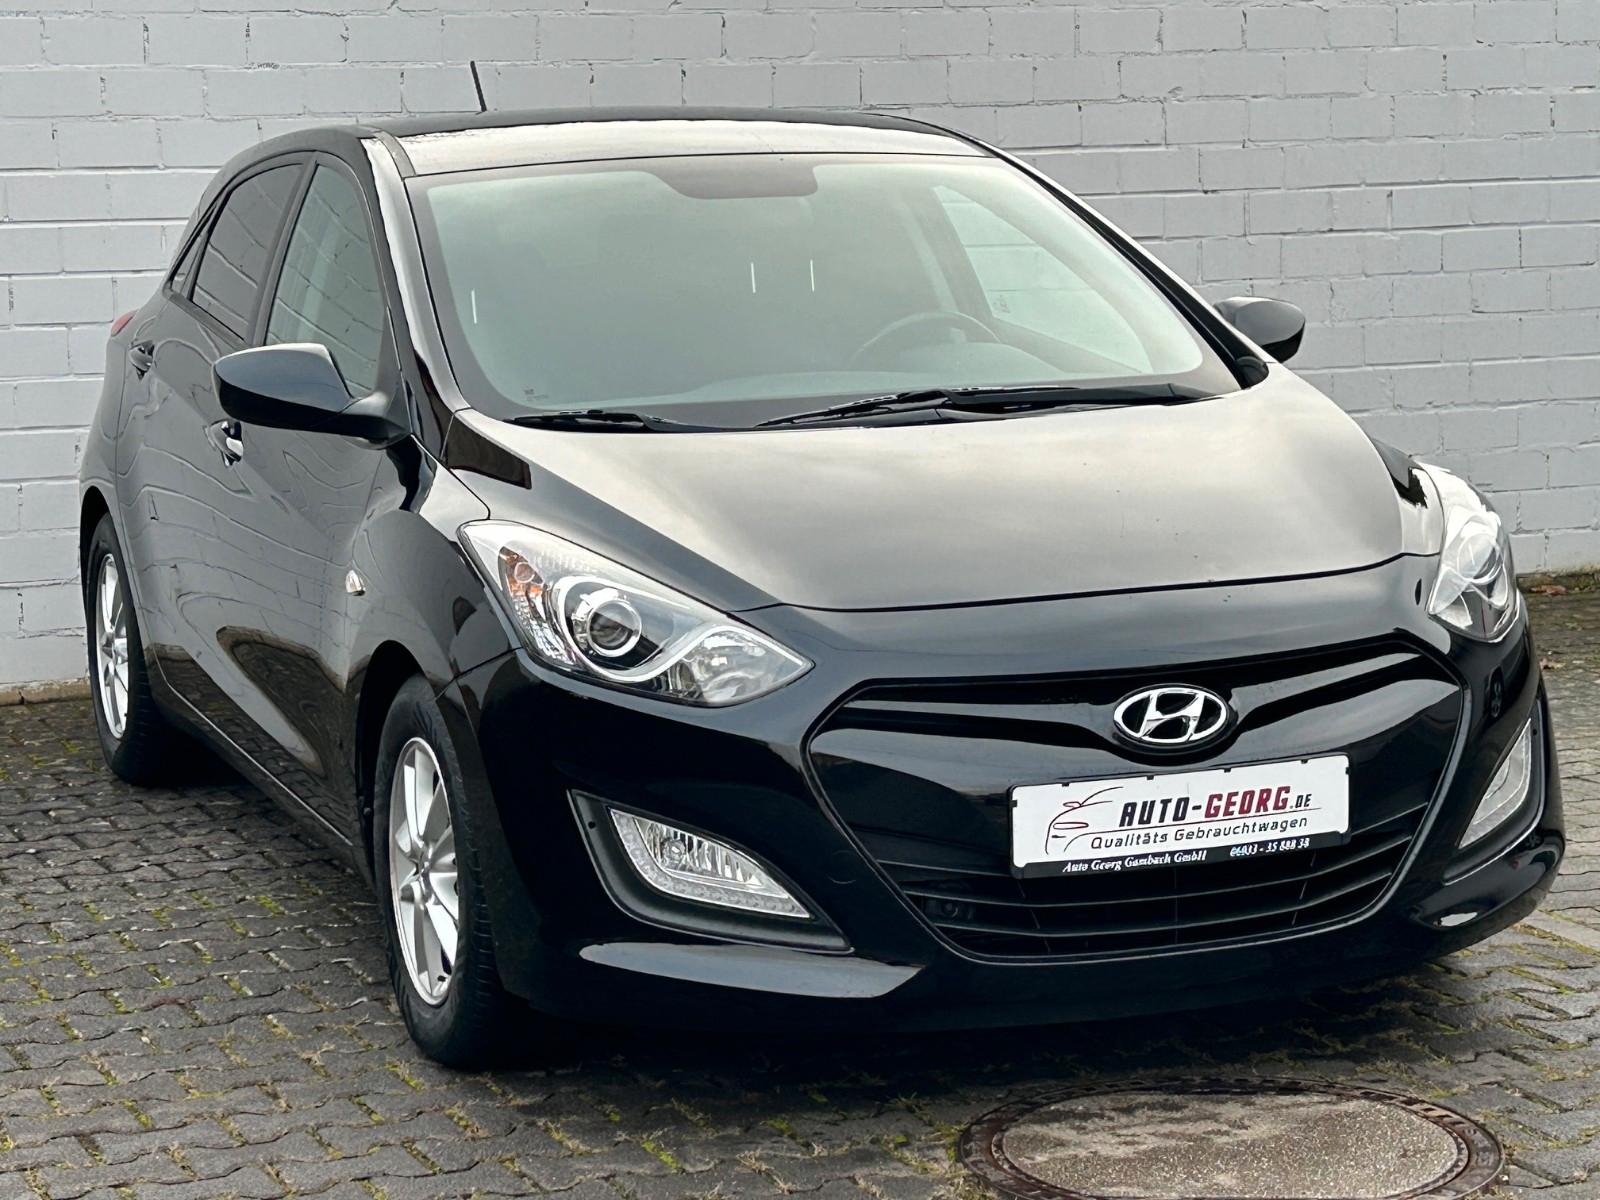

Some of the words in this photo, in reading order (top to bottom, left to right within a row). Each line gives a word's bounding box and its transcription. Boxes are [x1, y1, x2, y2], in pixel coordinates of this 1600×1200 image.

[1090, 833, 1168, 849] Qualitäts
[1174, 817, 1308, 841] Gebrauchtwagen
[1062, 862, 1088, 872] Auto
[1091, 860, 1122, 871] Georg
